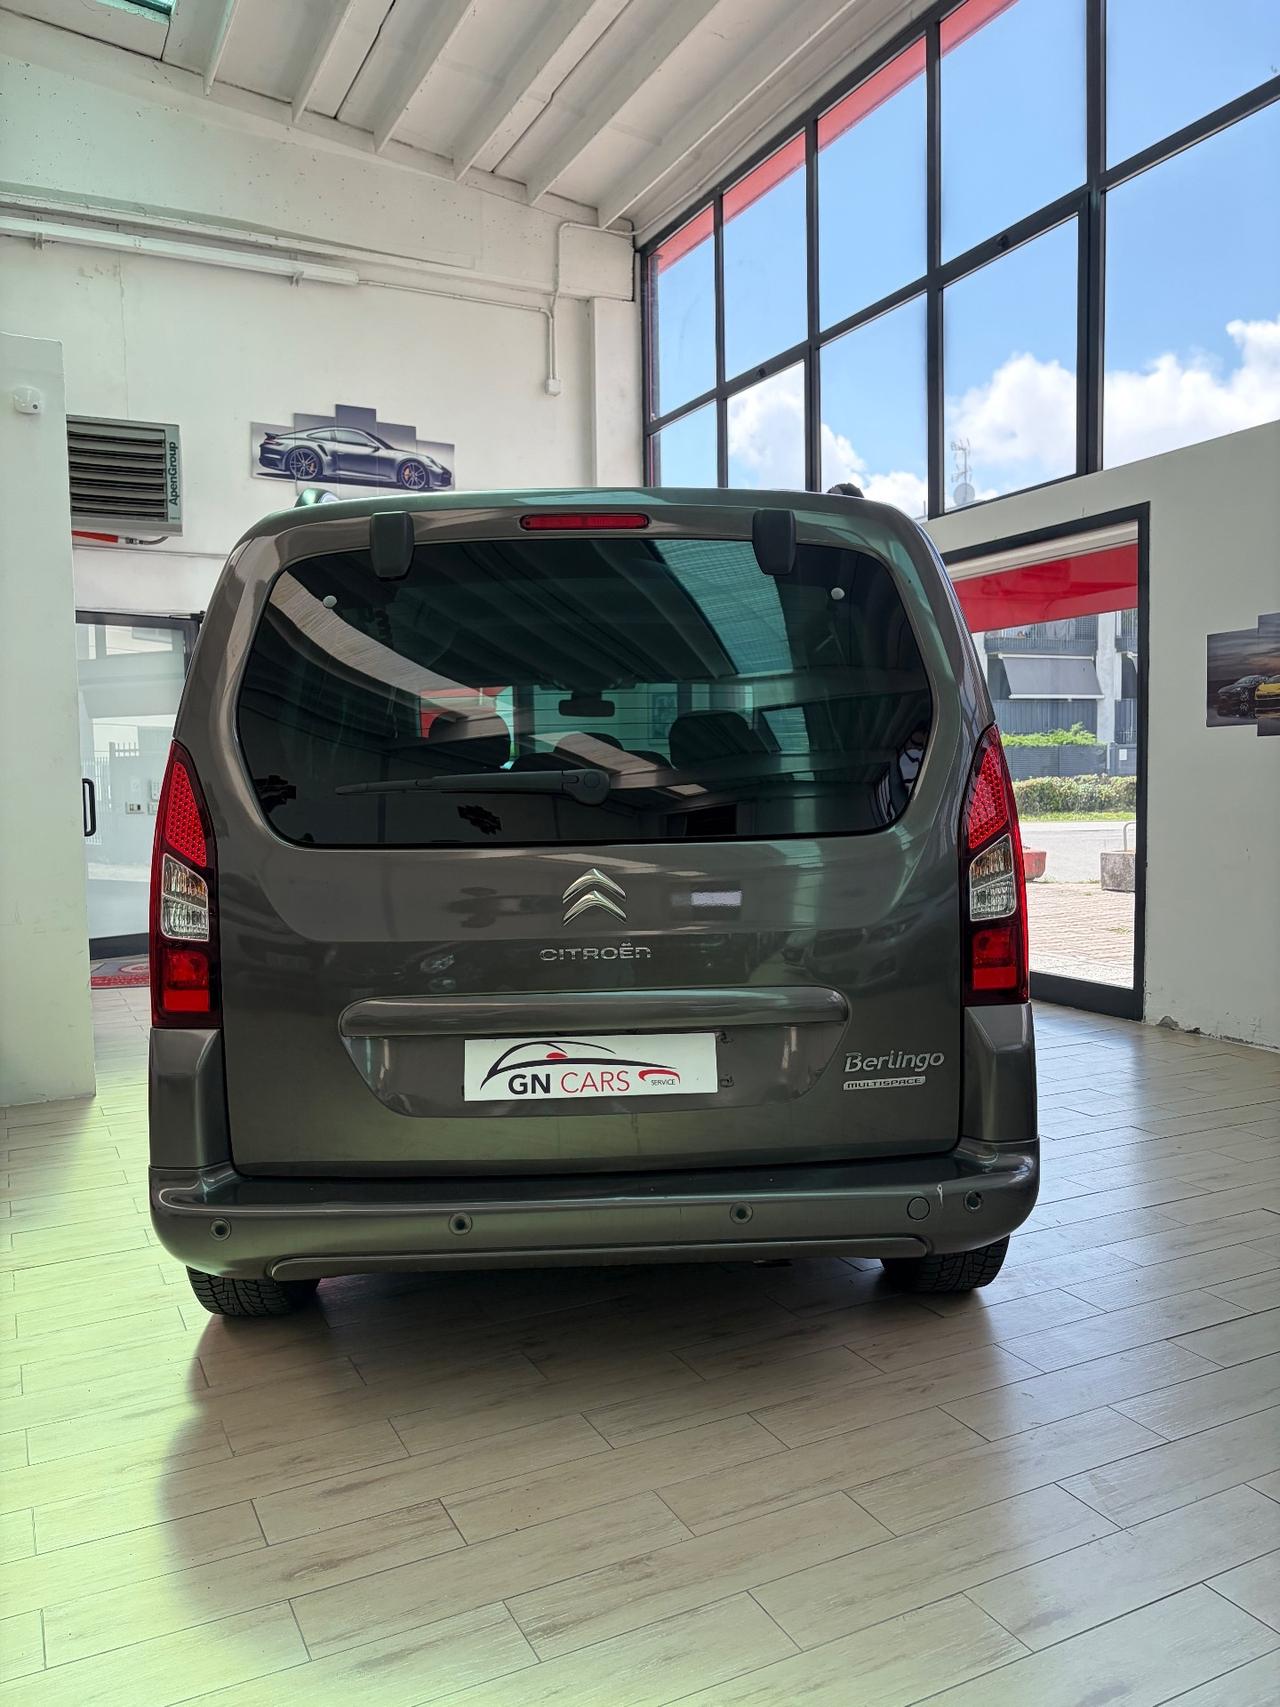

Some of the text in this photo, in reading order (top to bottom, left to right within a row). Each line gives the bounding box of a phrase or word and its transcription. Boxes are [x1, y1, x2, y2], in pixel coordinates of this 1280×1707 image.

[168, 441, 179, 506] ApenGroup
[844, 1050, 945, 1072] Berlingo
[508, 1070, 630, 1094] GN CARS
[651, 1078, 676, 1086] SERVICE
[846, 1078, 922, 1089] MULTISPACE
